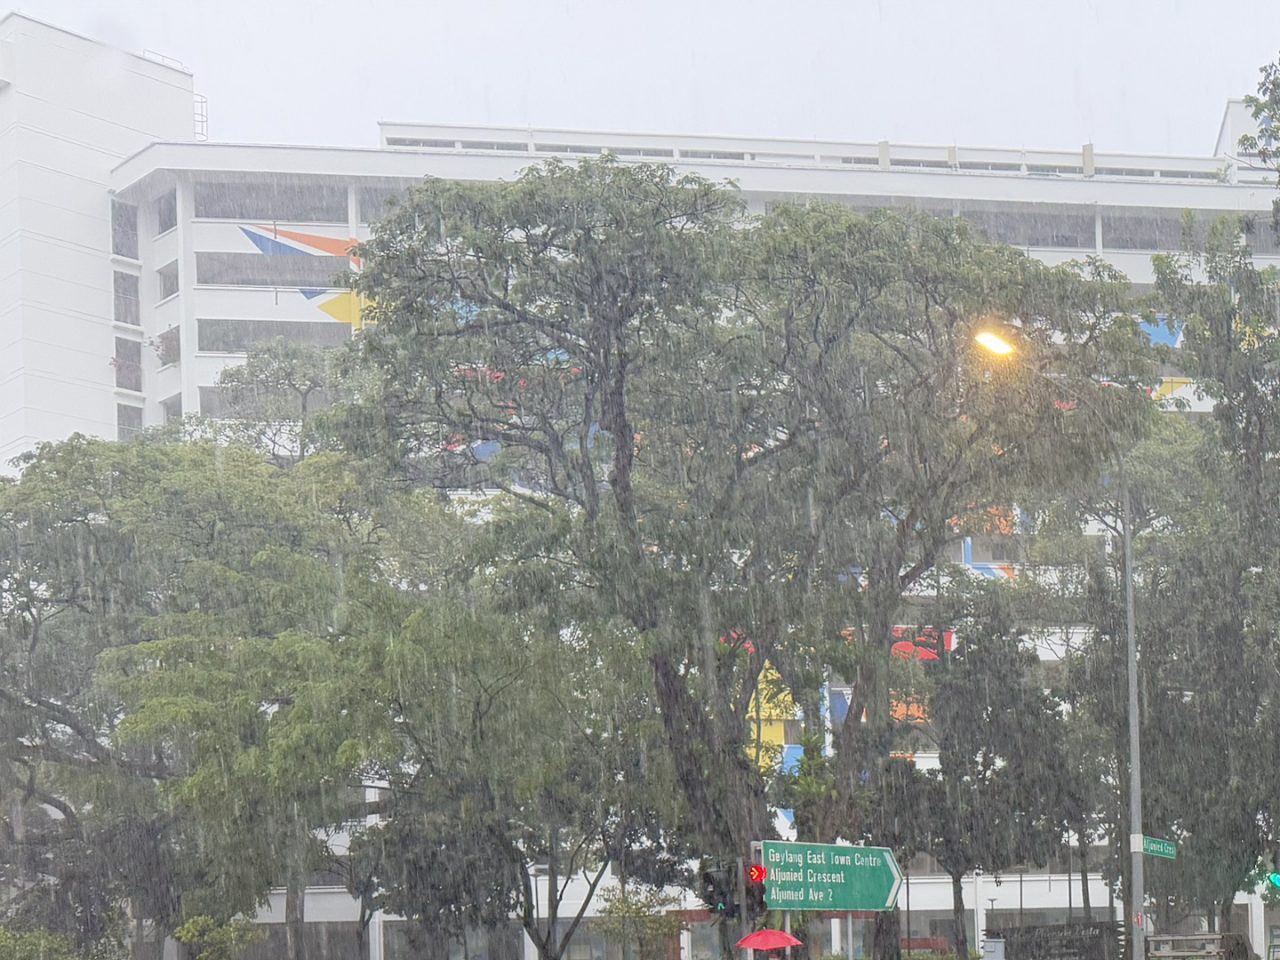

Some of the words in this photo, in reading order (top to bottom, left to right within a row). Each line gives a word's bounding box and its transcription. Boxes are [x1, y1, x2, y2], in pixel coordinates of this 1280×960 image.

[768, 848, 803, 866] Geylang
[807, 850, 826, 864] East
[831, 852, 851, 865] Town
[855, 853, 881, 867] Centre
[770, 867, 803, 884] Aljunied
[807, 869, 845, 883] Crescent
[770, 887, 804, 903] Aljunied
[809, 888, 824, 901] Ave
[828, 889, 833, 901] 2
